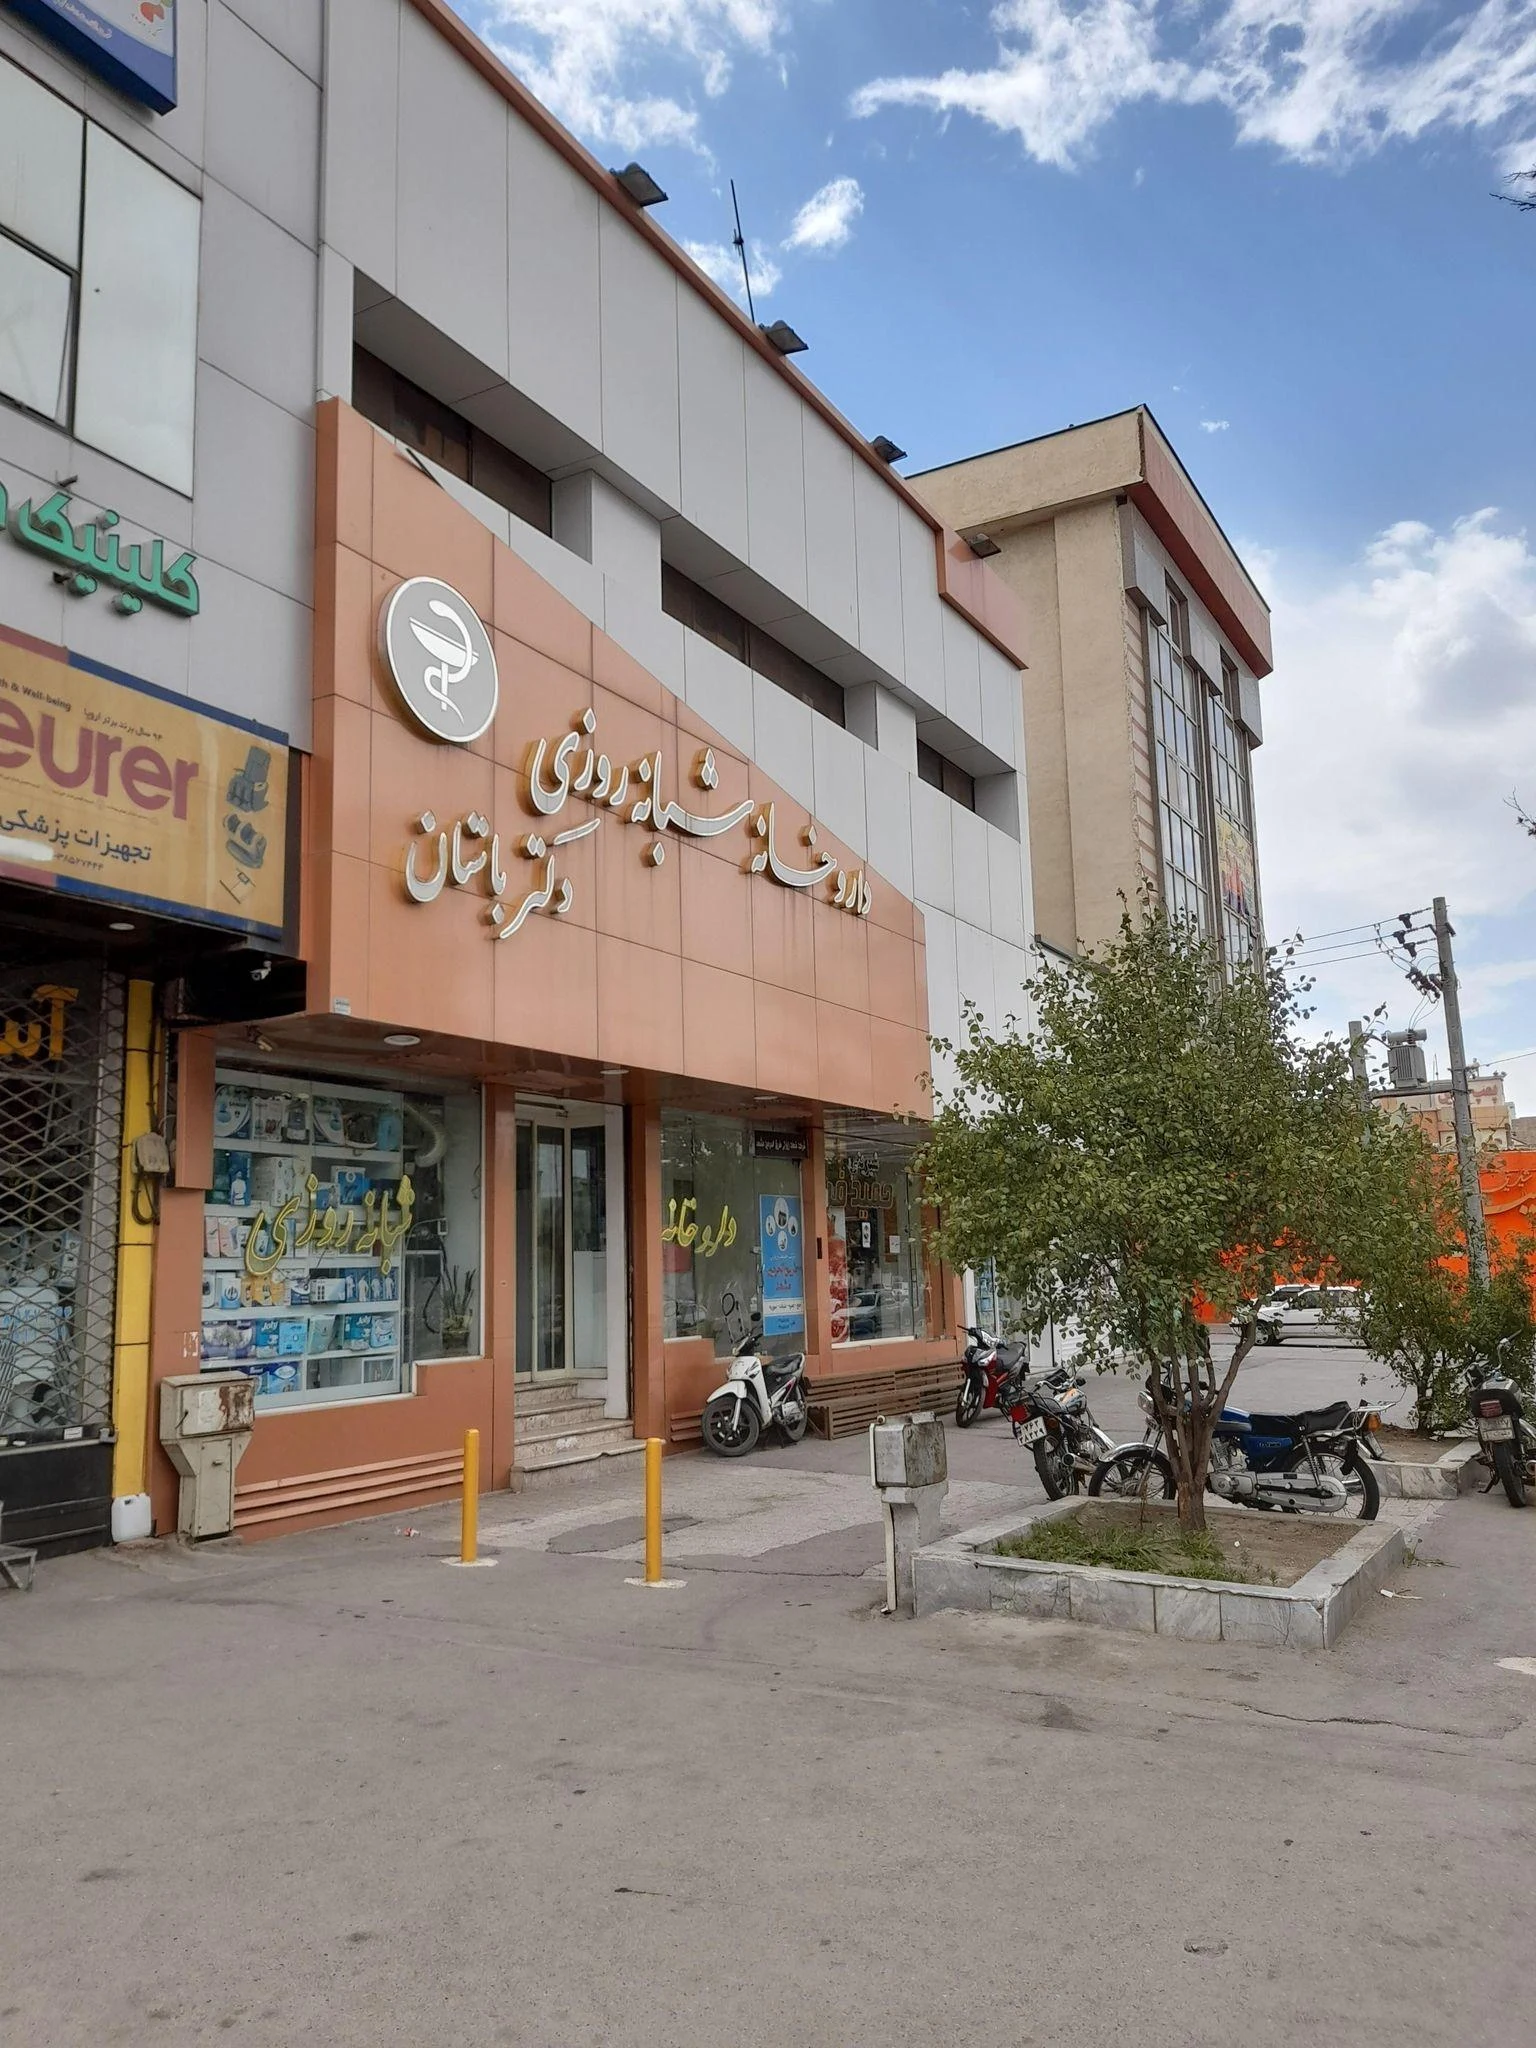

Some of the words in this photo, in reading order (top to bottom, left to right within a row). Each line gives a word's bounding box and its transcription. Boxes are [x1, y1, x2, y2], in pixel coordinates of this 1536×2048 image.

[17, 490, 200, 618] کلینیک
[0, 809, 71, 849] پزشکی
[74, 829, 152, 864] تجهیزات
[402, 808, 508, 927] باستان
